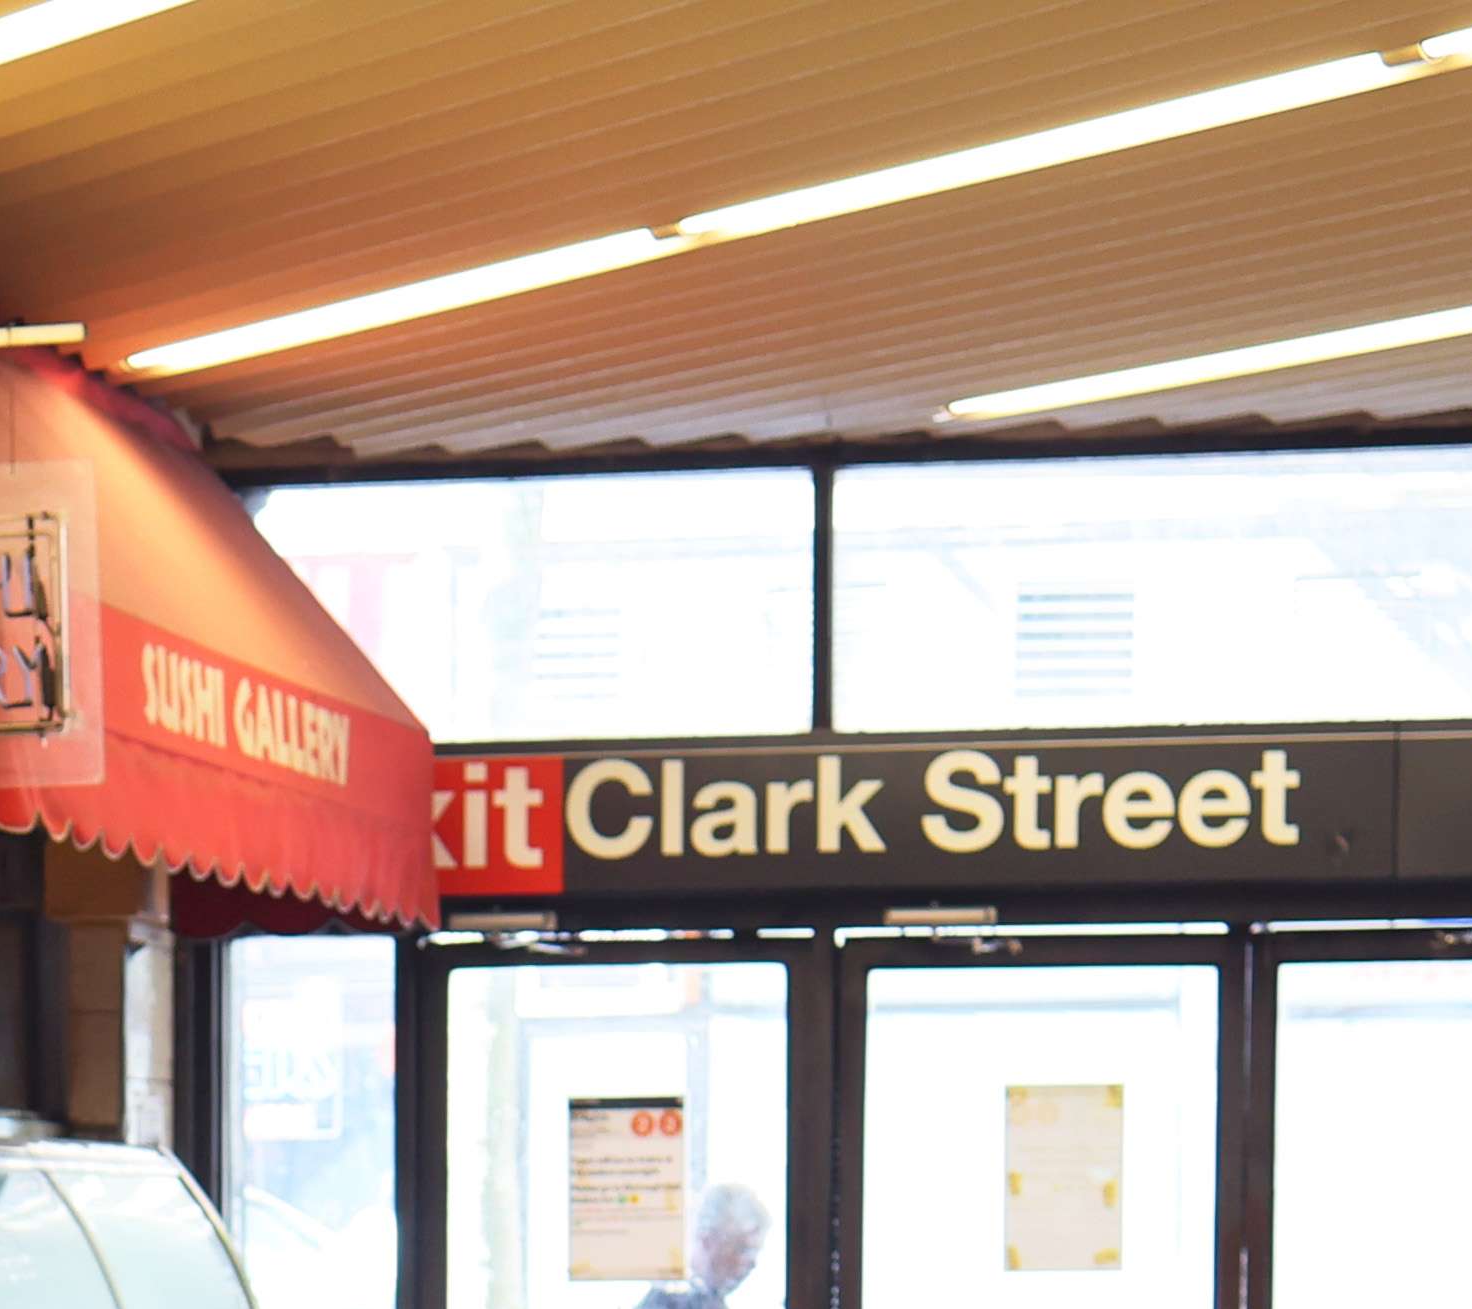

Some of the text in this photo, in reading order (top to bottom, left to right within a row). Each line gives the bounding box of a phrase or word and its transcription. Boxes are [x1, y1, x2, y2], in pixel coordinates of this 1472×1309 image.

[141, 641, 350, 788] SUSHI GALLERY
[565, 754, 886, 860] Clark
[921, 749, 1301, 851] Street
